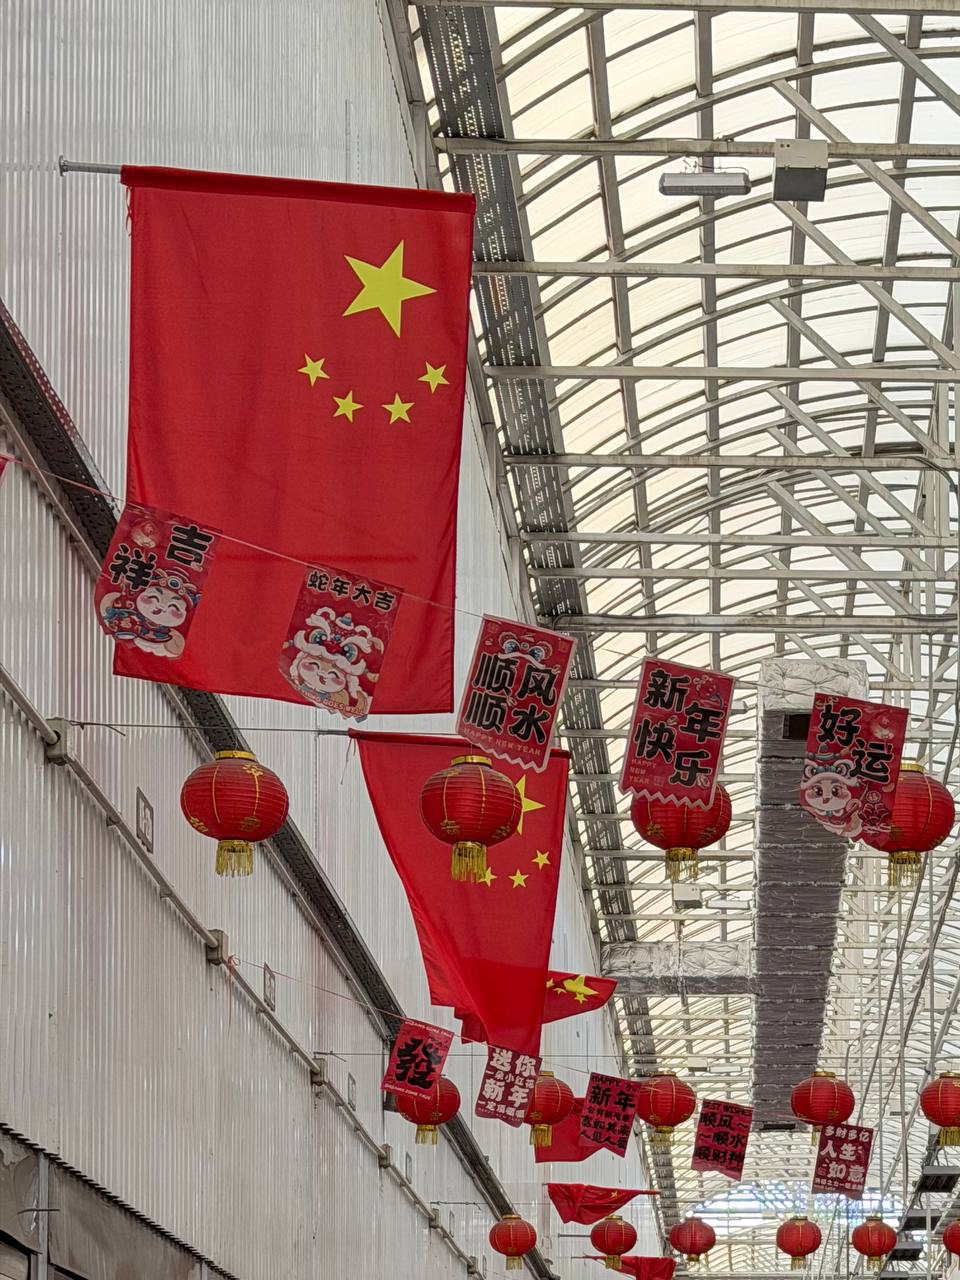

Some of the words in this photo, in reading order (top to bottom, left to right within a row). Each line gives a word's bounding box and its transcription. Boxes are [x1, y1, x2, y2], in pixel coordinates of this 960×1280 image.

[307, 571, 395, 612] 蛇年大吉
[464, 728, 493, 742] HAPPY
[516, 743, 542, 756] YEAR
[817, 703, 894, 784] 好运
[589, 1084, 636, 1112] 新年
